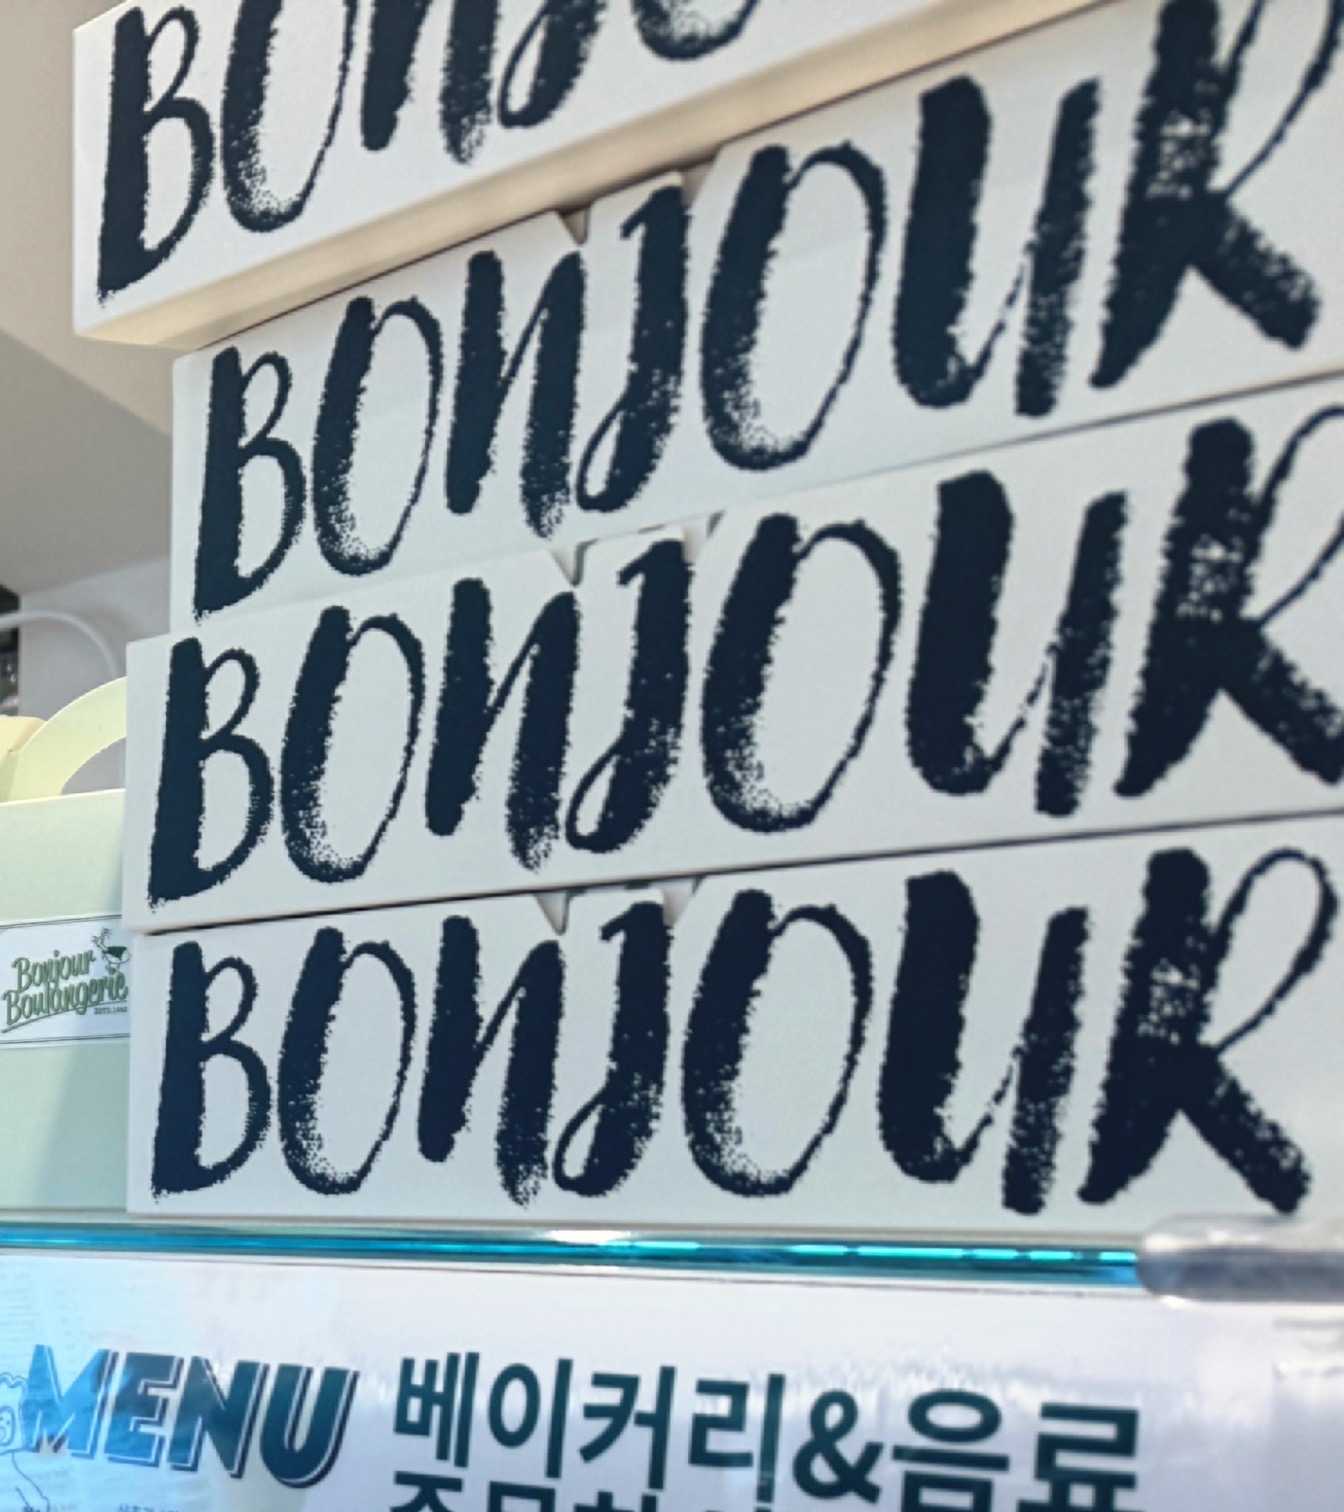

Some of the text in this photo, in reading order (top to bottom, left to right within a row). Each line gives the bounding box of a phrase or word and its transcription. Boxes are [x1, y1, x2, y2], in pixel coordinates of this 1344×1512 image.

[194, 0, 1342, 624] BONJOUR
[147, 404, 1344, 915] BONJOUR
[1, 971, 129, 1026] Boulangerie
[11, 949, 96, 994] Bonjour
[150, 846, 1338, 1217] BONJOUR
[22, 1344, 360, 1489] MENU
